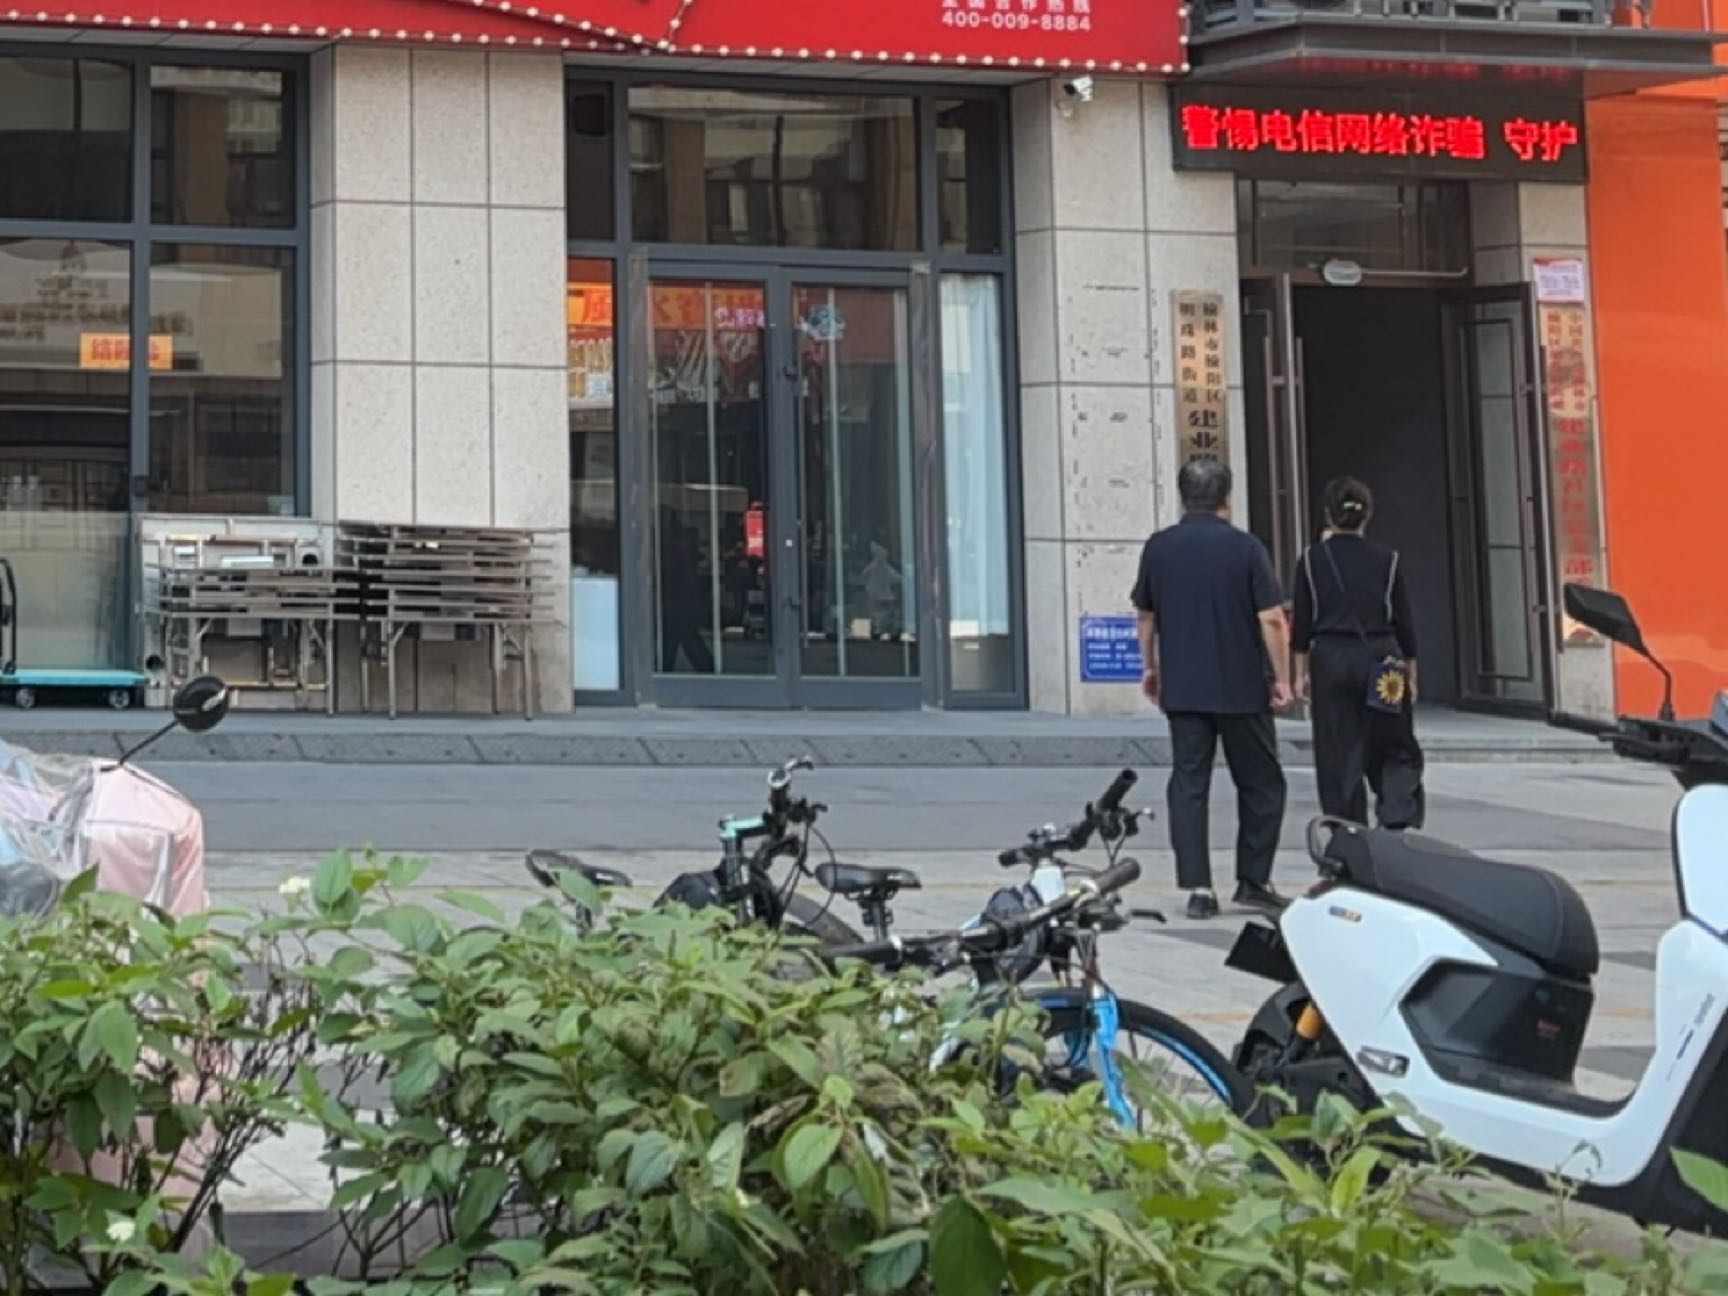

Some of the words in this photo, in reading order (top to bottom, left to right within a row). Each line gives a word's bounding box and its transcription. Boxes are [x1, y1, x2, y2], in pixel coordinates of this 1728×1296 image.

[1181, 104, 1485, 160] 警惕电信网络诈骗
[1504, 117, 1579, 161] 守护
